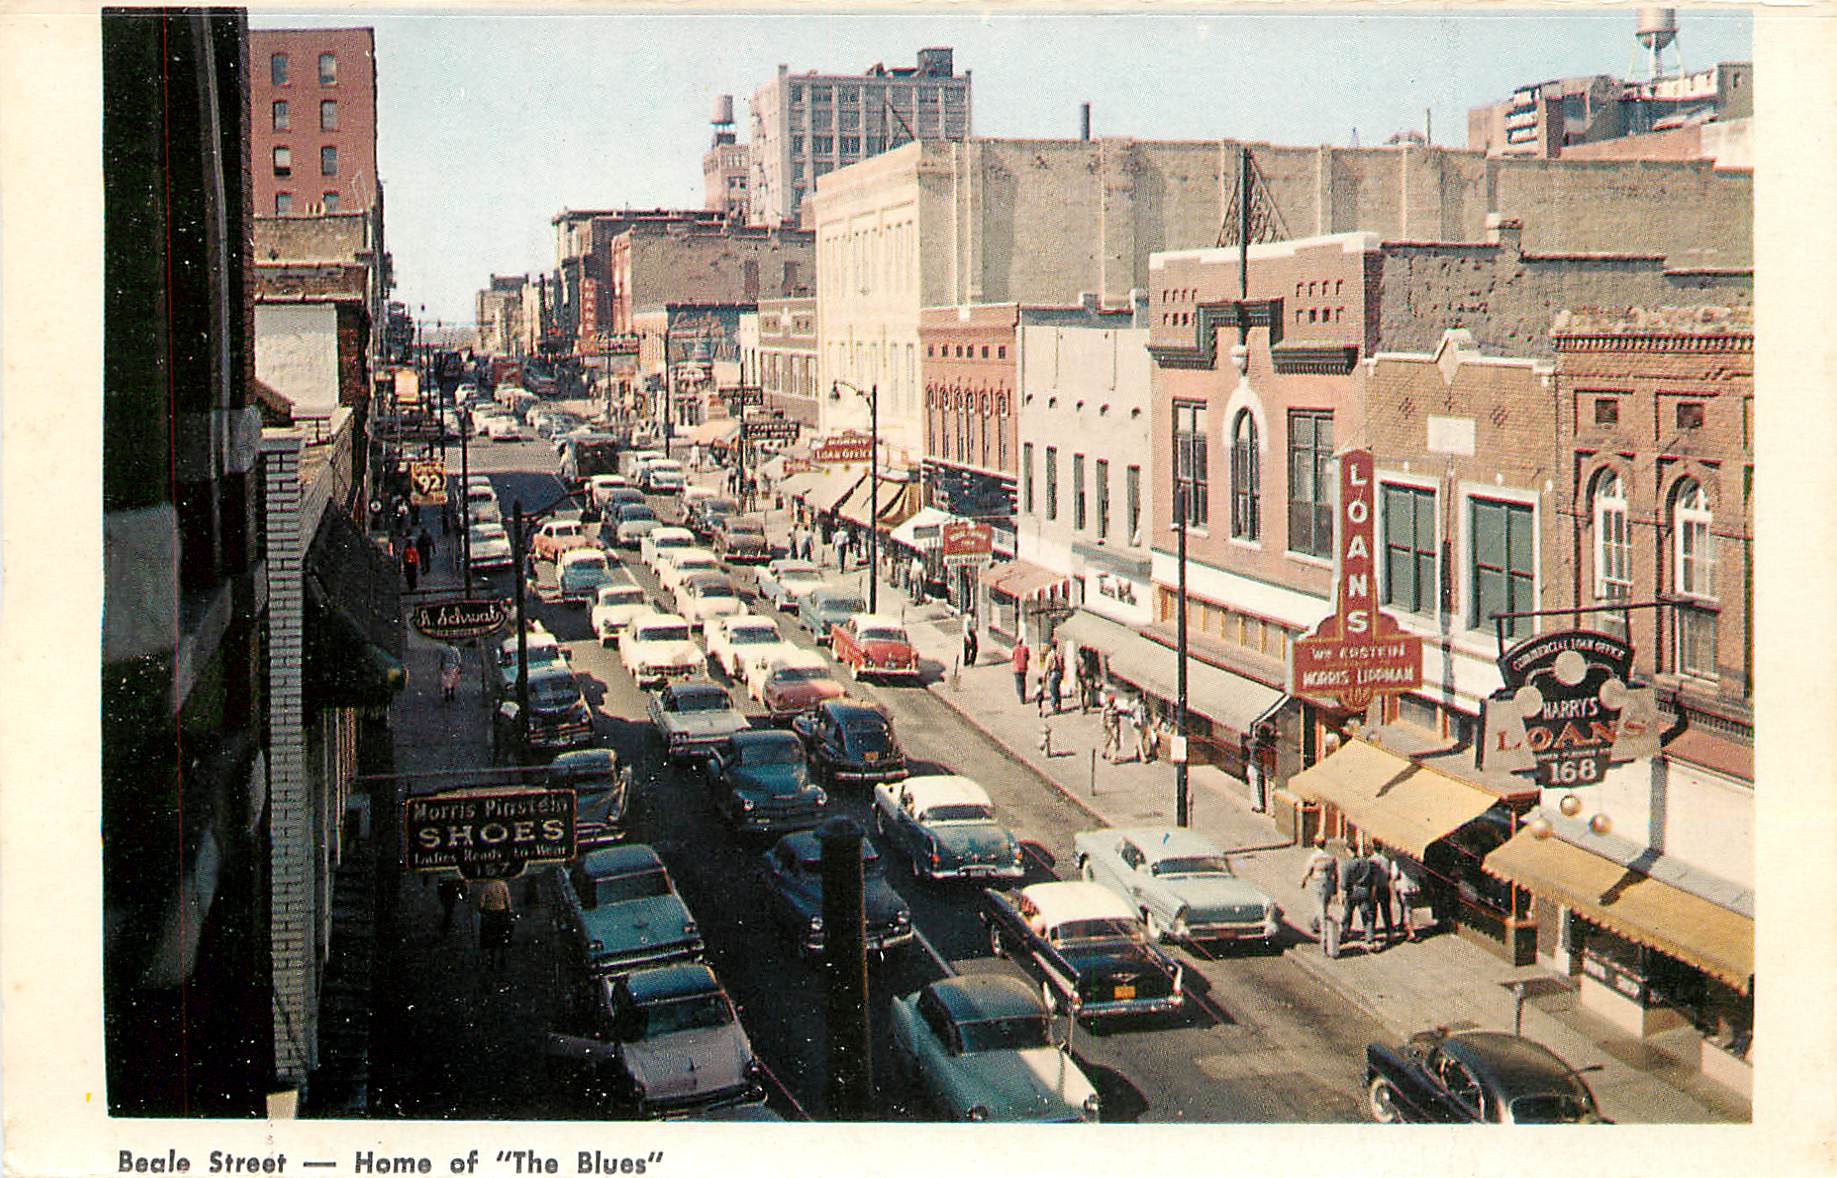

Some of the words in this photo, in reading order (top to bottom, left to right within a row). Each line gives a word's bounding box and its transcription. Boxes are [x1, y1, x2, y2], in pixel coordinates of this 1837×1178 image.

[418, 474, 441, 493] 92
[1347, 463, 1369, 633] LOANS
[1512, 640, 1568, 671] COMMERCIAL
[1570, 637, 1594, 650] LOAN
[1594, 641, 1626, 661] OFFICE
[1302, 669, 1350, 688] MORRIS
[1357, 663, 1415, 684] LIPPMAN
[1496, 719, 1648, 751] LOANS
[1551, 759, 1597, 783] 168
[414, 801, 477, 820] Morris
[418, 819, 565, 849] SHOES
